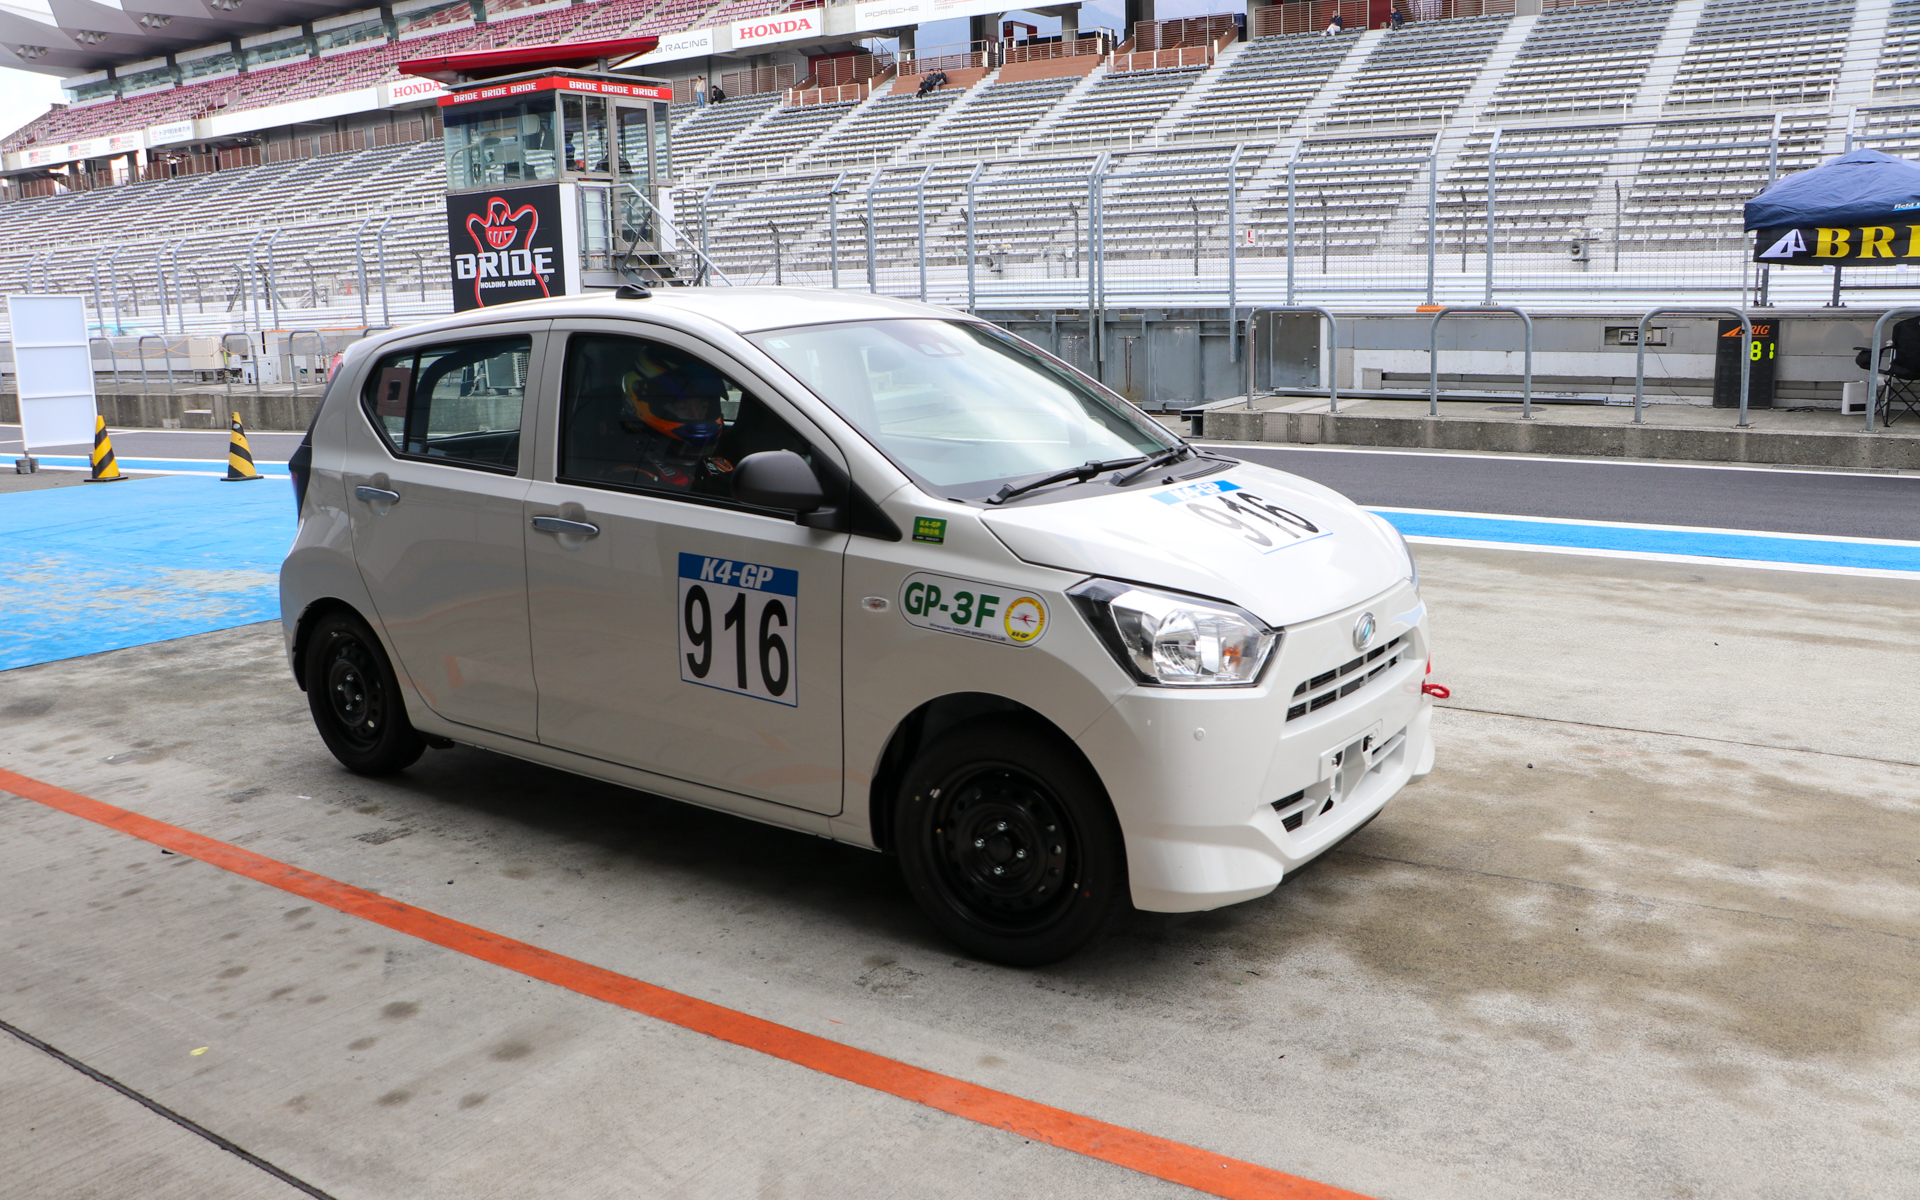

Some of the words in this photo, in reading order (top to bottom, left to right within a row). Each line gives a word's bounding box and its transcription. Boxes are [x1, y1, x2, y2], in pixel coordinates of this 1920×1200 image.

[864, 5, 919, 18] PORSCHE
[739, 18, 813, 40] HONDA
[665, 38, 708, 52] RACING
[393, 79, 442, 98] HONDA
[453, 91, 478, 103] BRIDE
[481, 87, 507, 98] BRIDE
[510, 82, 537, 93] BRIDE
[568, 81, 598, 92] BRIDE
[601, 84, 629, 95] BRIDE
[632, 87, 659, 98] BRIDE
[454, 247, 556, 280] BRIDE
[480, 280, 507, 289] HOLDING
[507, 279, 537, 288] MONSTER
[1750, 341, 1775, 361] 81
[1168, 482, 1222, 501] K4-GP
[920, 520, 941, 528] K4-GP
[1186, 492, 1319, 547] 916
[700, 557, 774, 590] K4-GP
[904, 581, 1000, 628] GP-3F
[684, 584, 789, 697] 916
